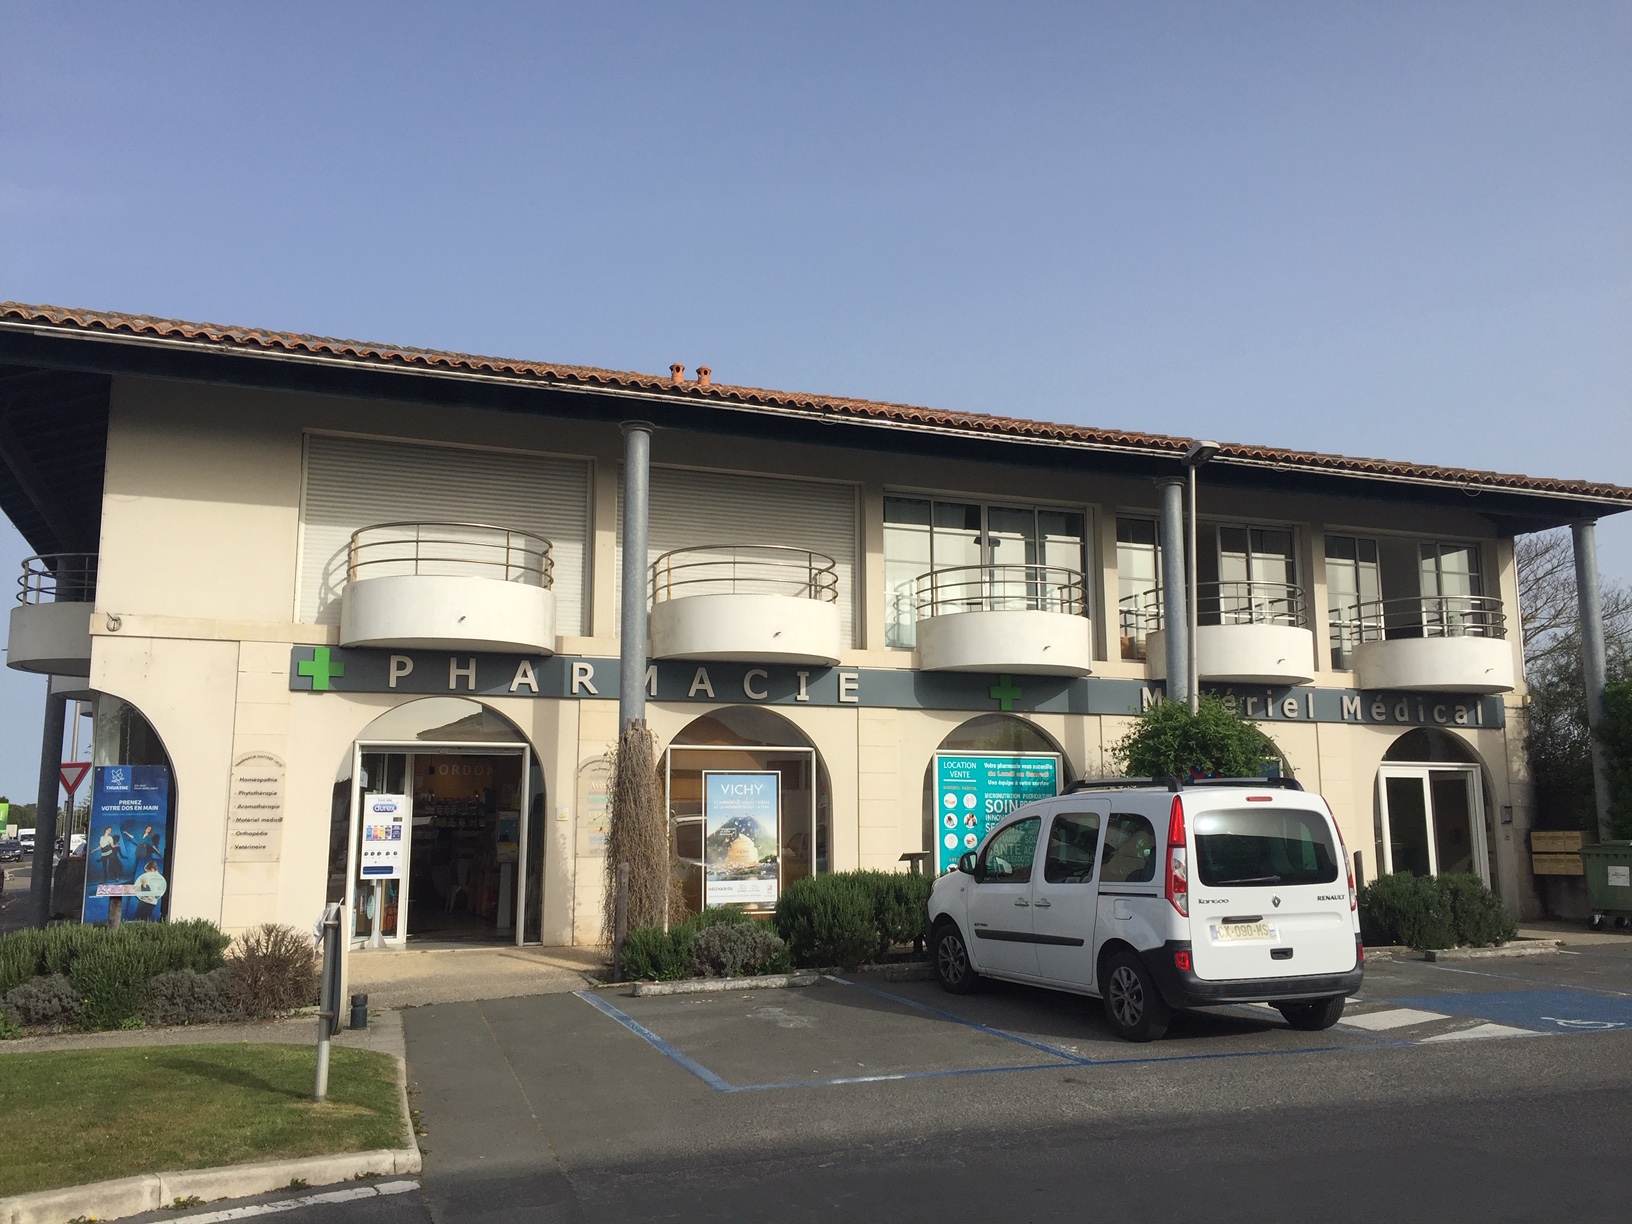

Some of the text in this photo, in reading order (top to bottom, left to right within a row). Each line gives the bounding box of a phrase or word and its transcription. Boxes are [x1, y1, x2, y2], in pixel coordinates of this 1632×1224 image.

[1141, 686, 1483, 726] Mériel Médical
[943, 761, 977, 769] LOCATION
[949, 770, 971, 778] VENTE
[720, 783, 764, 795] VICHY
[374, 804, 396, 812] durex
[1317, 894, 1346, 902] RENAULT
